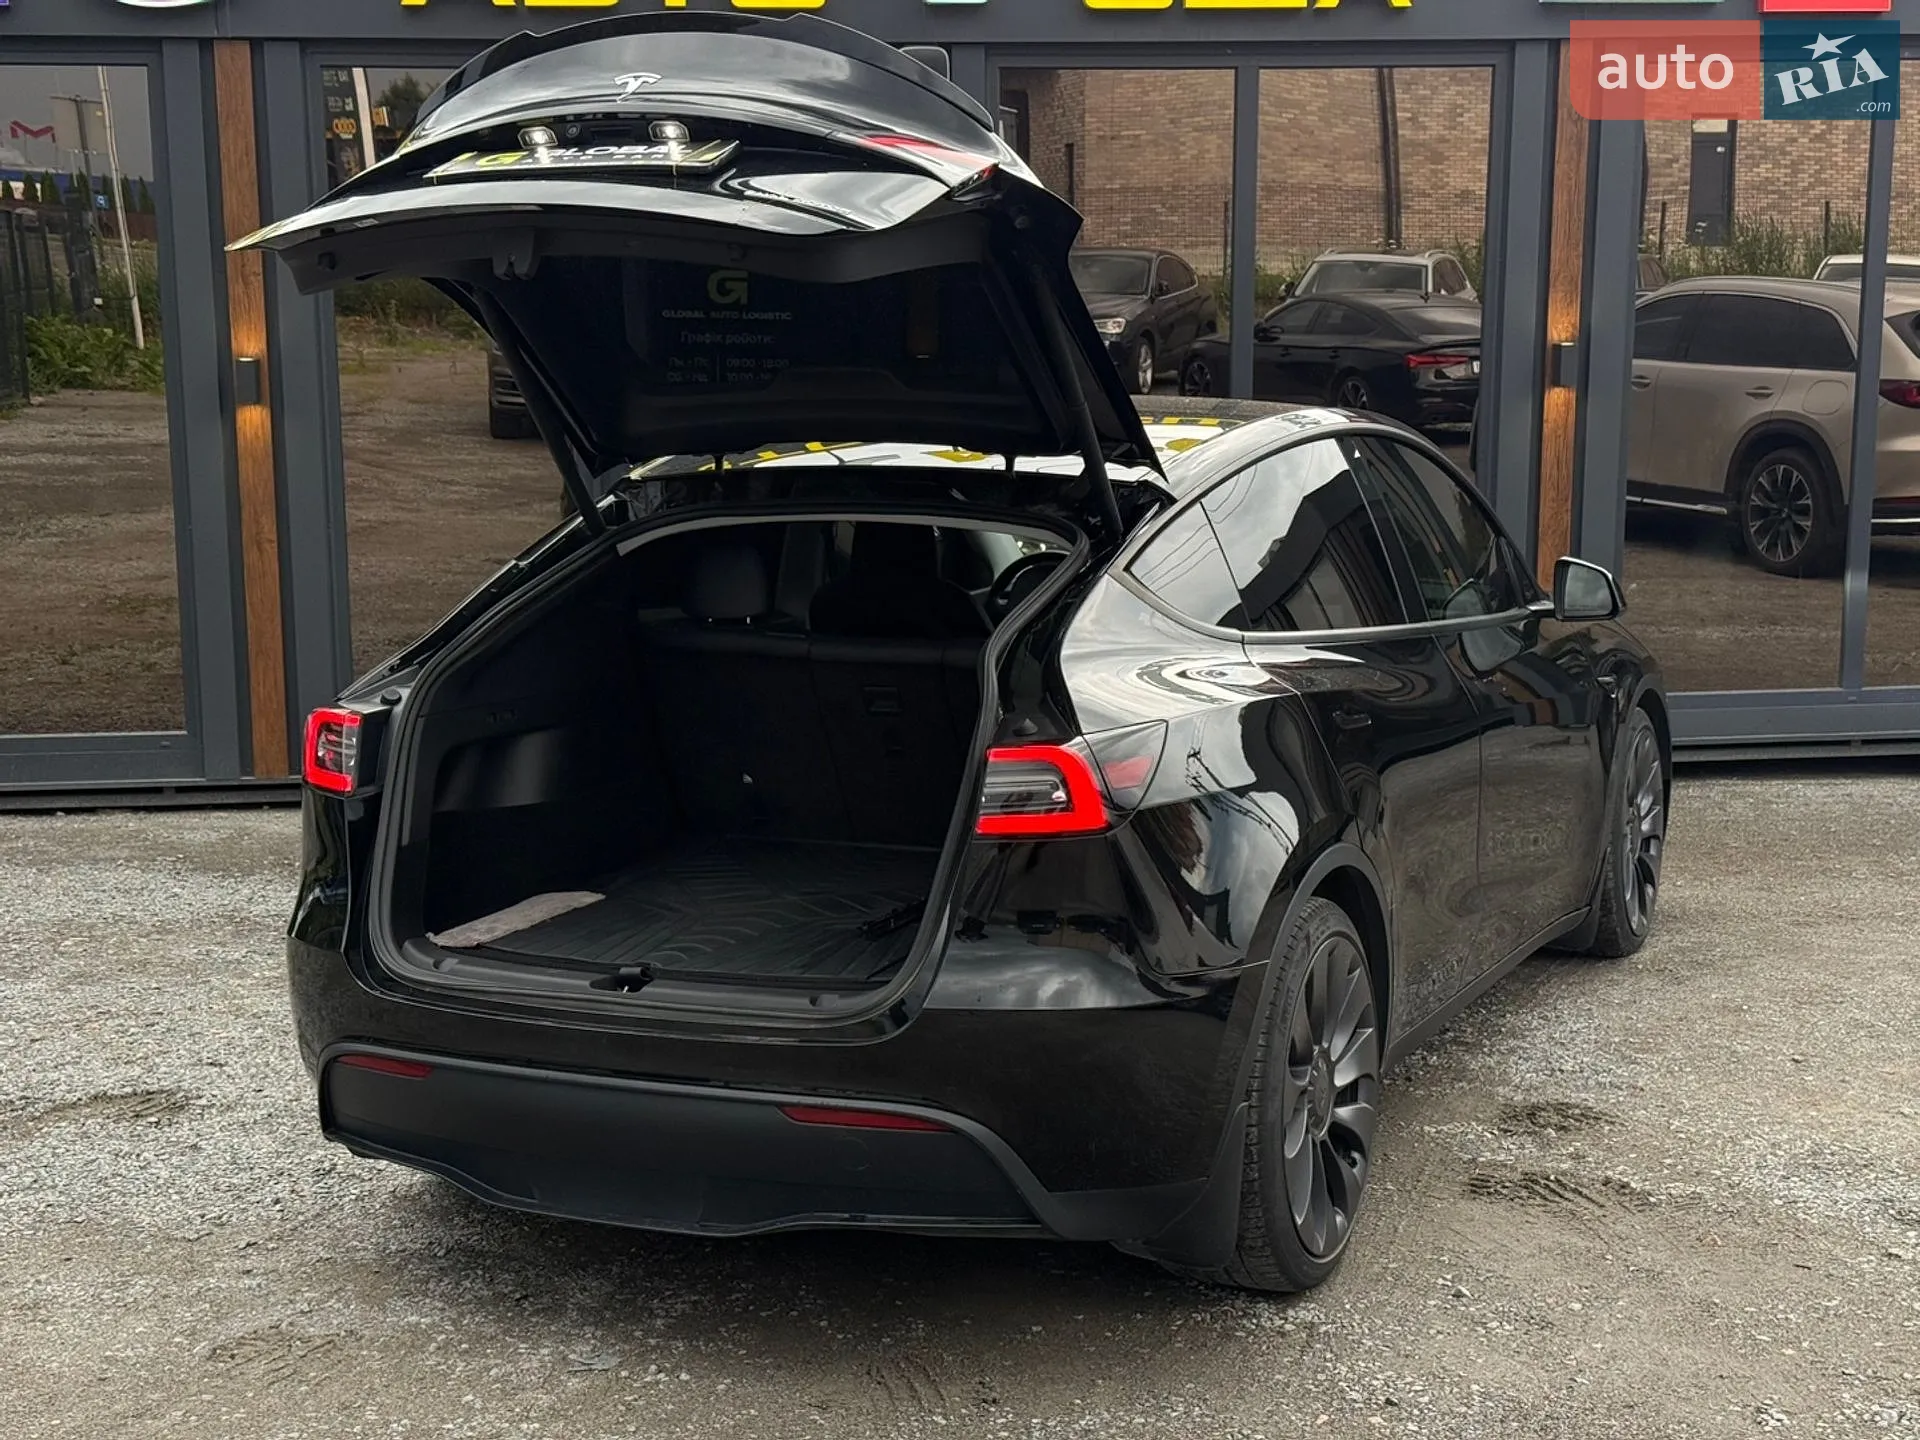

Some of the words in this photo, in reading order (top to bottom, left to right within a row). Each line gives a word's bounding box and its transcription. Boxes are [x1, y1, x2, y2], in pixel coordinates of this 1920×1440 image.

[661, 309, 706, 318] GLOBAL
[709, 311, 740, 319] AUTO
[742, 311, 792, 320] LOGISTIC
[680, 331, 722, 344] Графік
